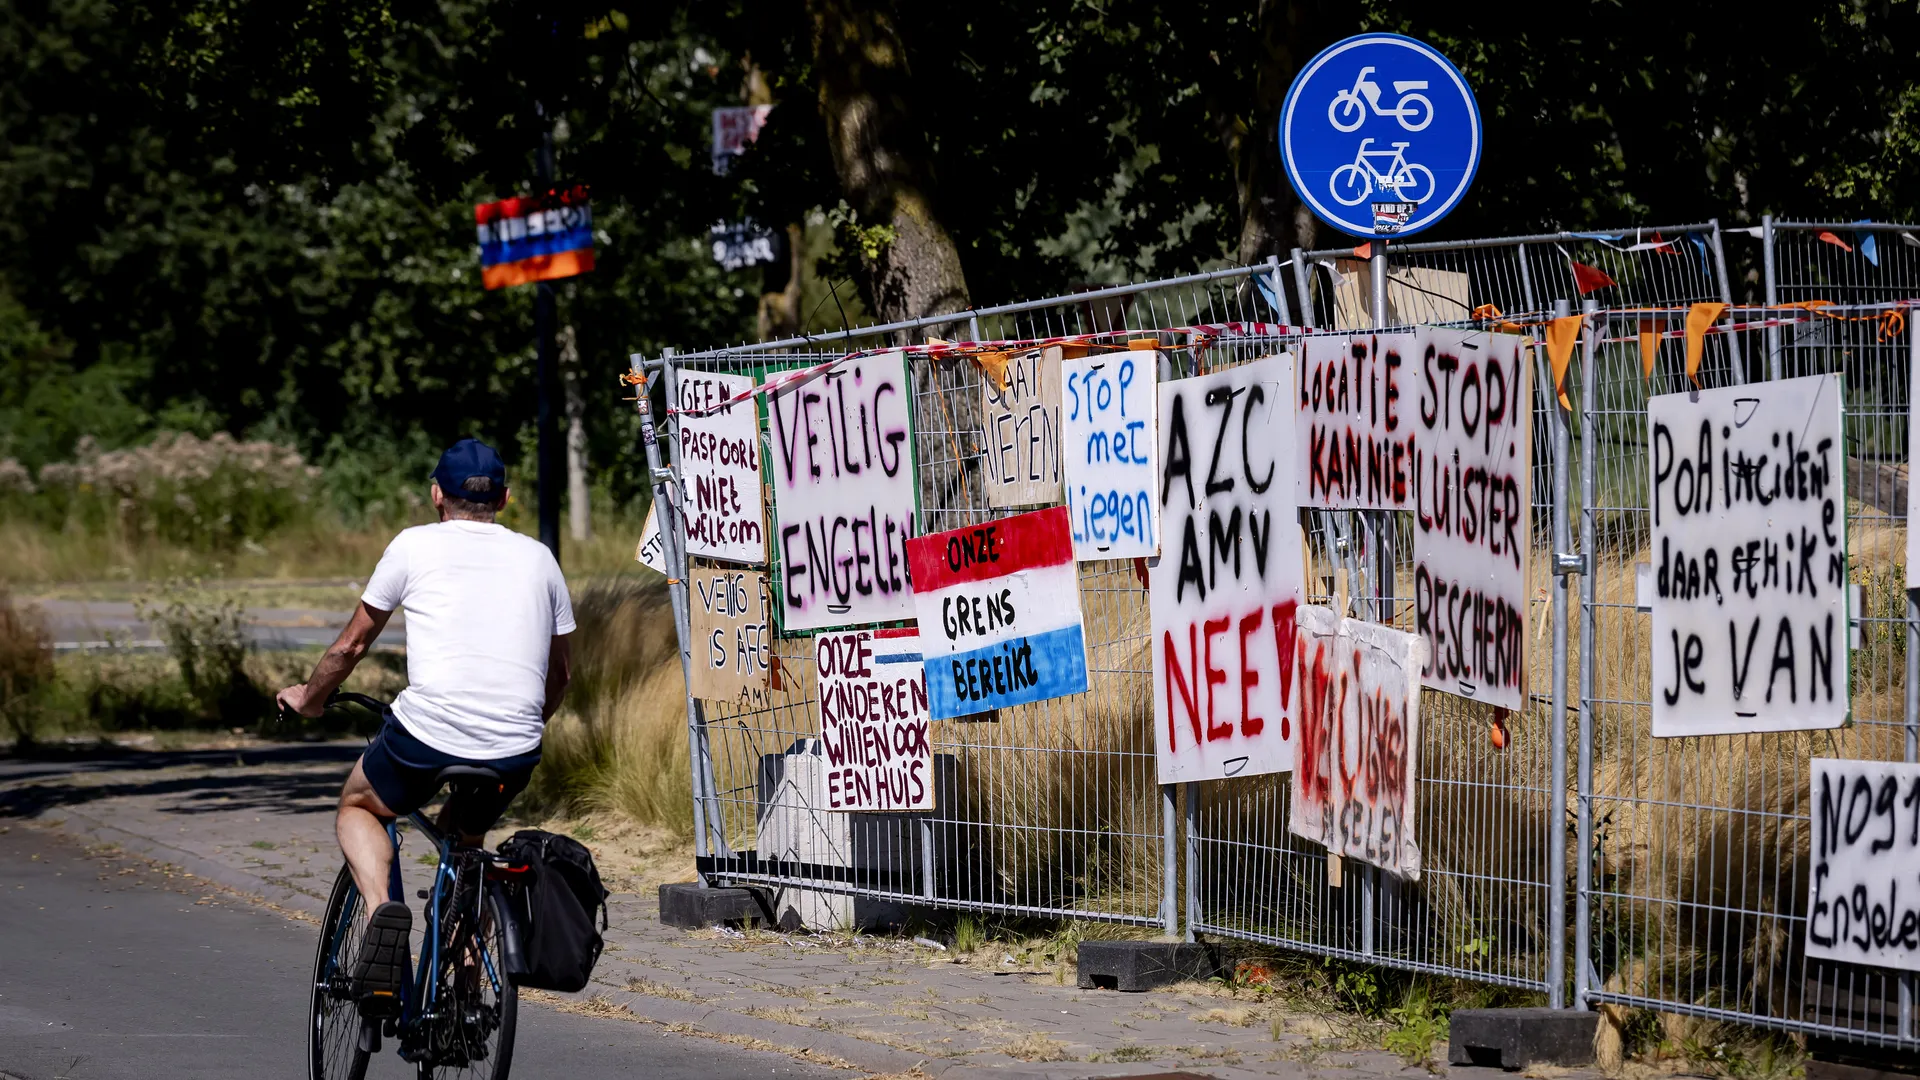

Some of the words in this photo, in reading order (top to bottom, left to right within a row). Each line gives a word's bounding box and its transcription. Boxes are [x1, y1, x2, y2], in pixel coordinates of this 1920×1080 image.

[681, 378, 732, 417] GEEN
[1420, 343, 1521, 458] STOP!
[1163, 385, 1275, 509] AZC
[1310, 423, 1362, 504] KAN
[947, 527, 1000, 573] ONZE
[1177, 505, 1271, 603] AMV
[943, 589, 1015, 641] GRENS
[1164, 599, 1299, 753] NEE!
[1729, 613, 1833, 704] VAN
[894, 718, 931, 758] OOK
[828, 769, 871, 808] EEN
[1810, 861, 1920, 952] Engele
